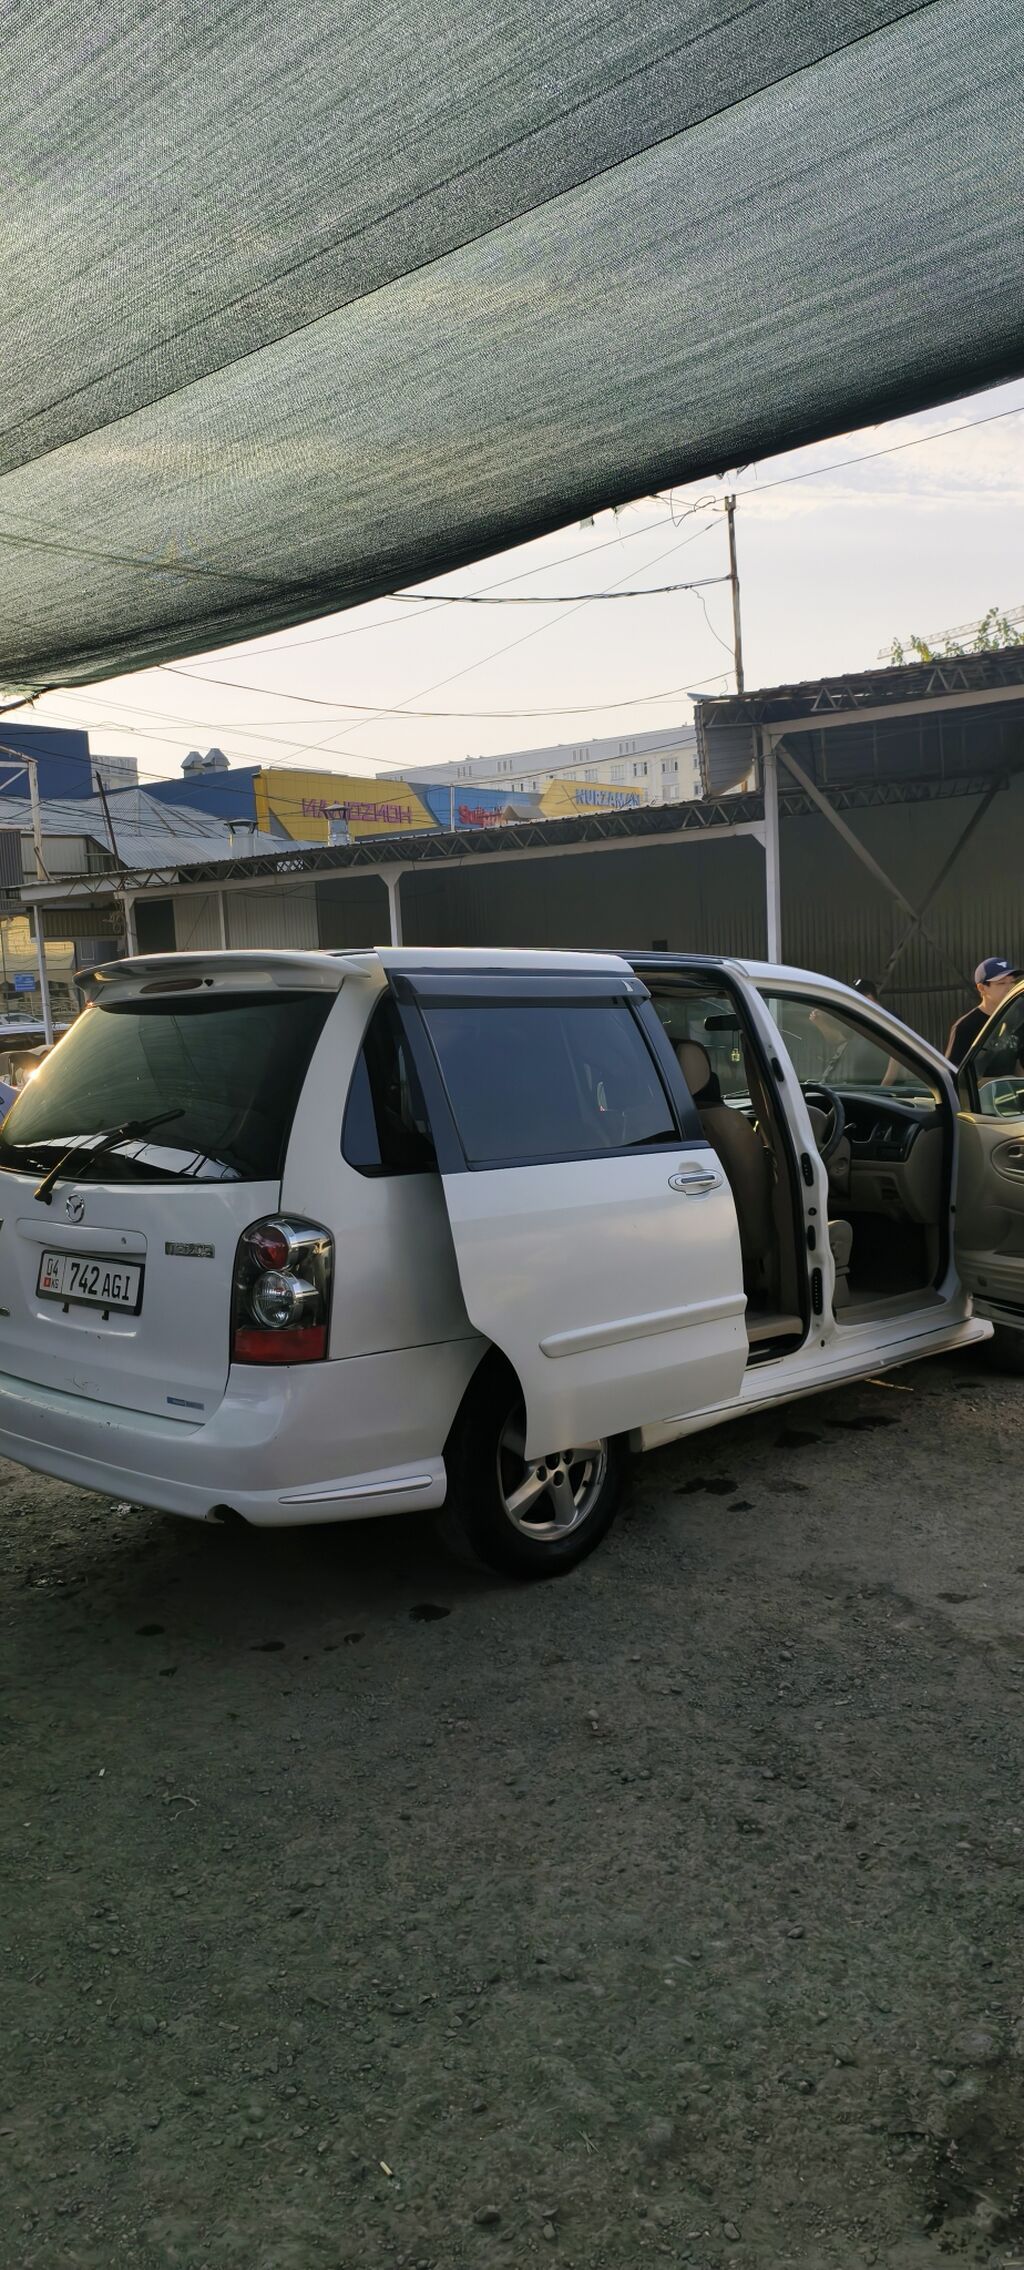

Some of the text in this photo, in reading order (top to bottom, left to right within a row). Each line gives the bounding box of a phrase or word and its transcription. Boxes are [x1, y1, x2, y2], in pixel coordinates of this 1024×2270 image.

[47, 1258, 59, 1277] 04
[69, 1262, 130, 1301] 742 AGI
